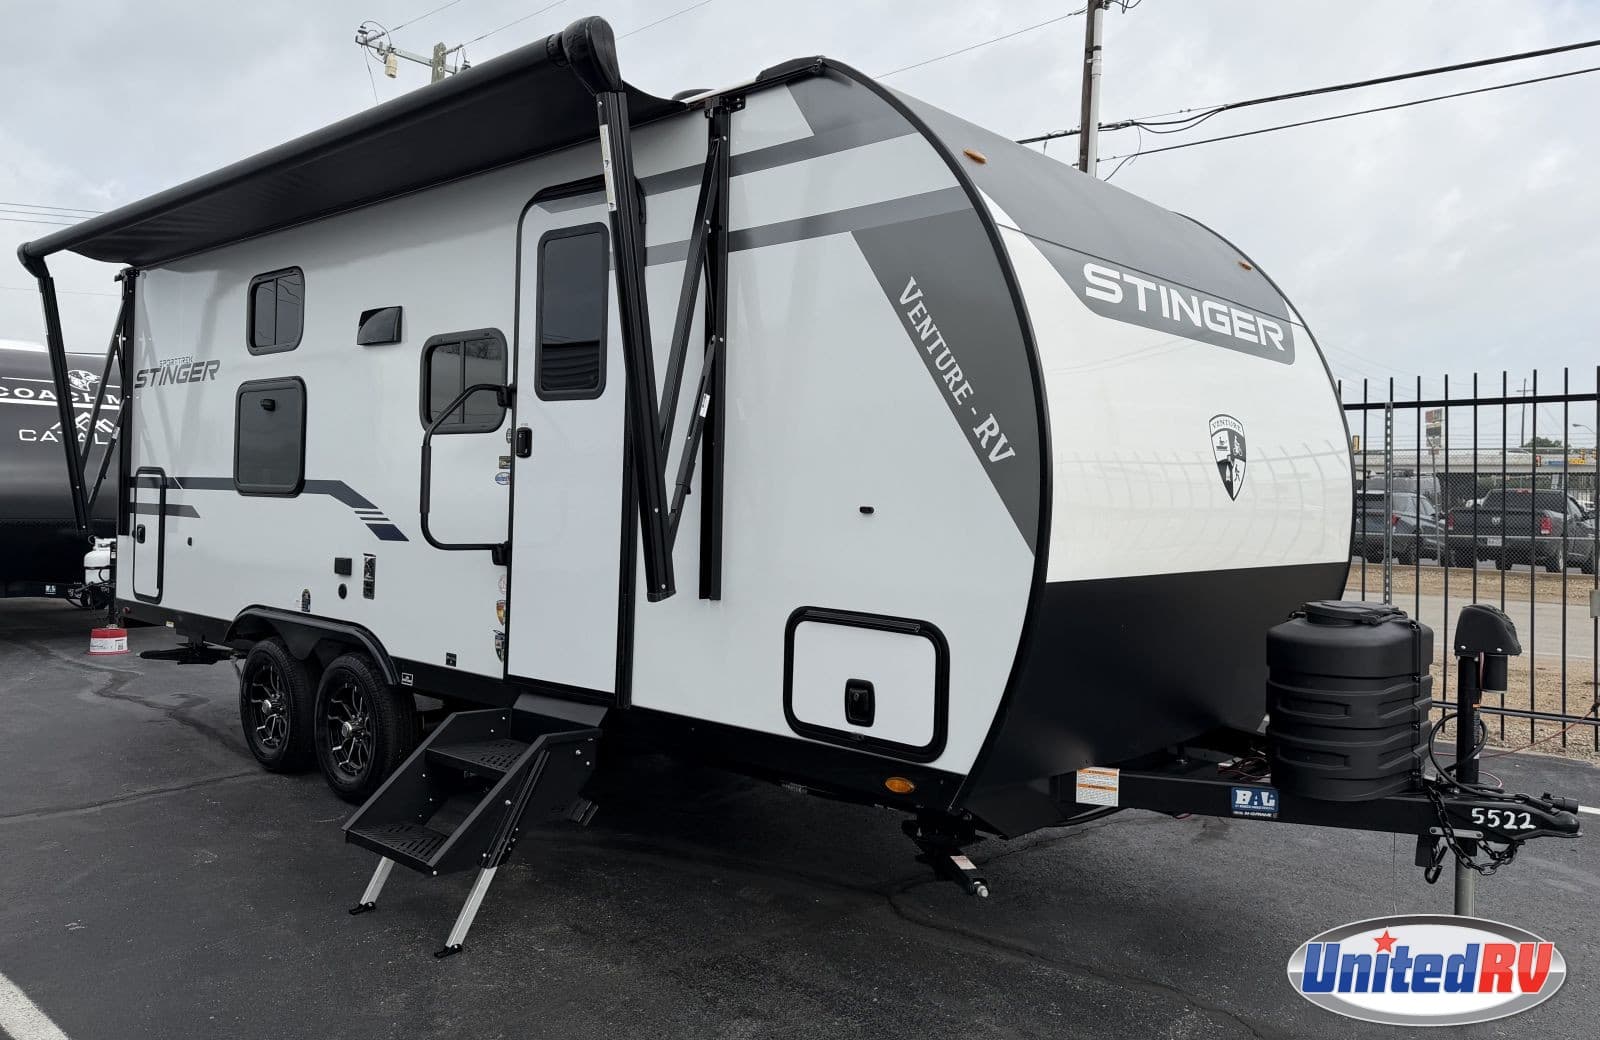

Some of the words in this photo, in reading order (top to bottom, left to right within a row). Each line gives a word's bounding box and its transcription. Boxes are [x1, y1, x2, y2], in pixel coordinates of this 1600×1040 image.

[1083, 262, 1285, 351] STINGER
[134, 359, 220, 389] STINGER
[900, 276, 974, 406] VENTURE
[973, 413, 1016, 463] RV
[1471, 807, 1537, 830] 5522
